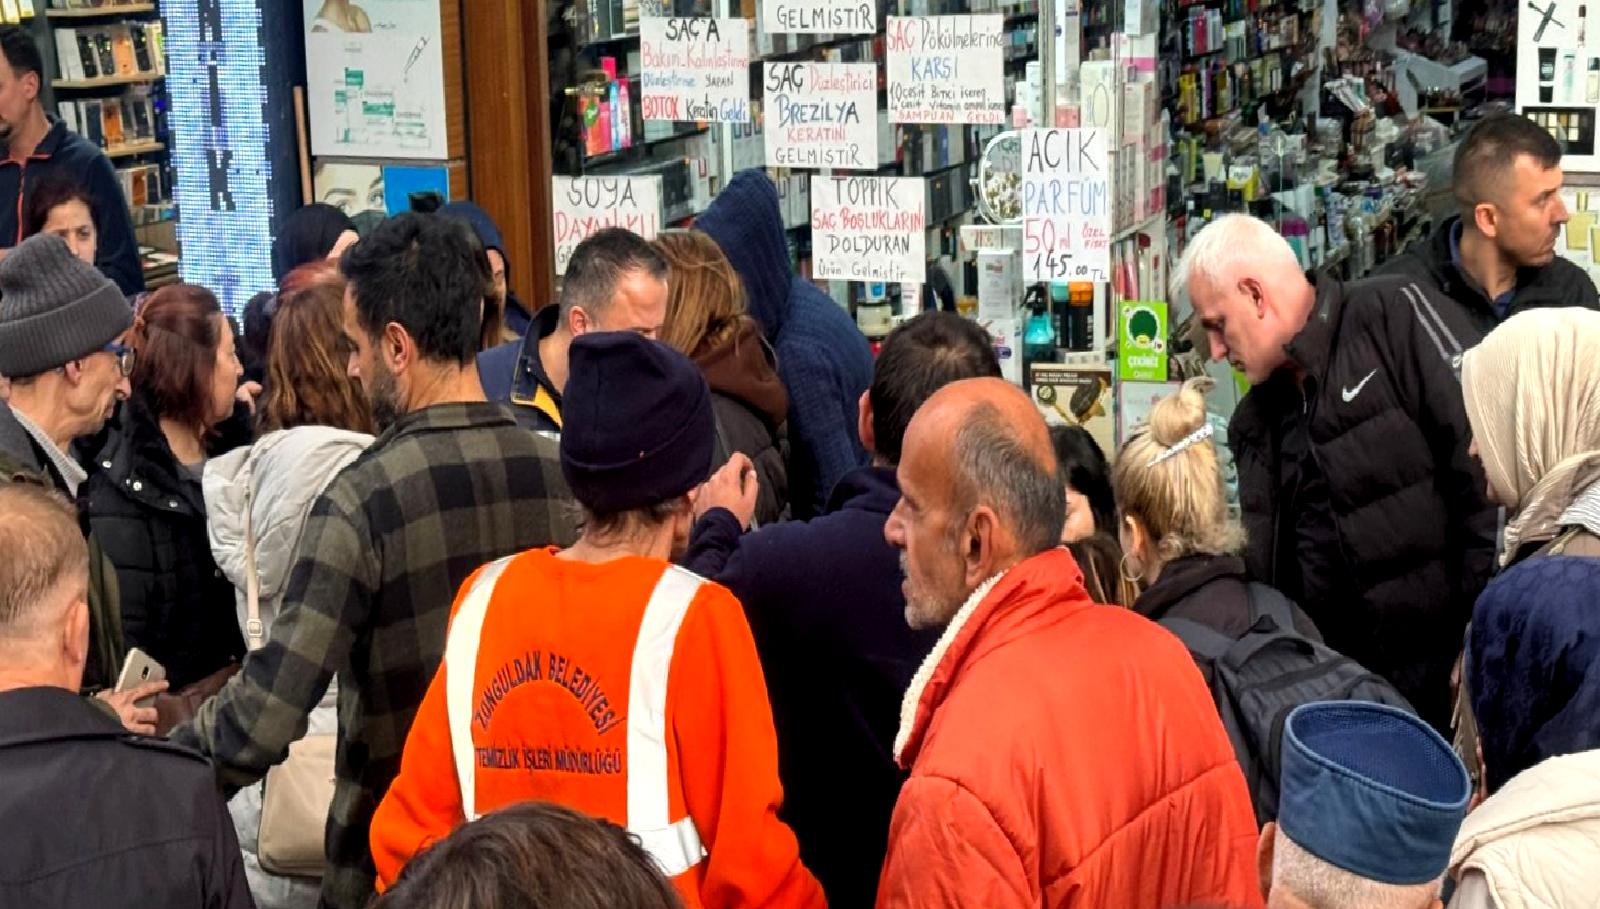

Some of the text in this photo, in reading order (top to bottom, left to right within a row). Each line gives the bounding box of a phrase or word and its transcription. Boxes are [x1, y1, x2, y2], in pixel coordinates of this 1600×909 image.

[766, 63, 805, 94] SAÇ
[1027, 130, 1100, 173] AÇIK
[825, 233, 910, 258] DOLDURAN
[475, 651, 543, 731] ZONGULDAK
